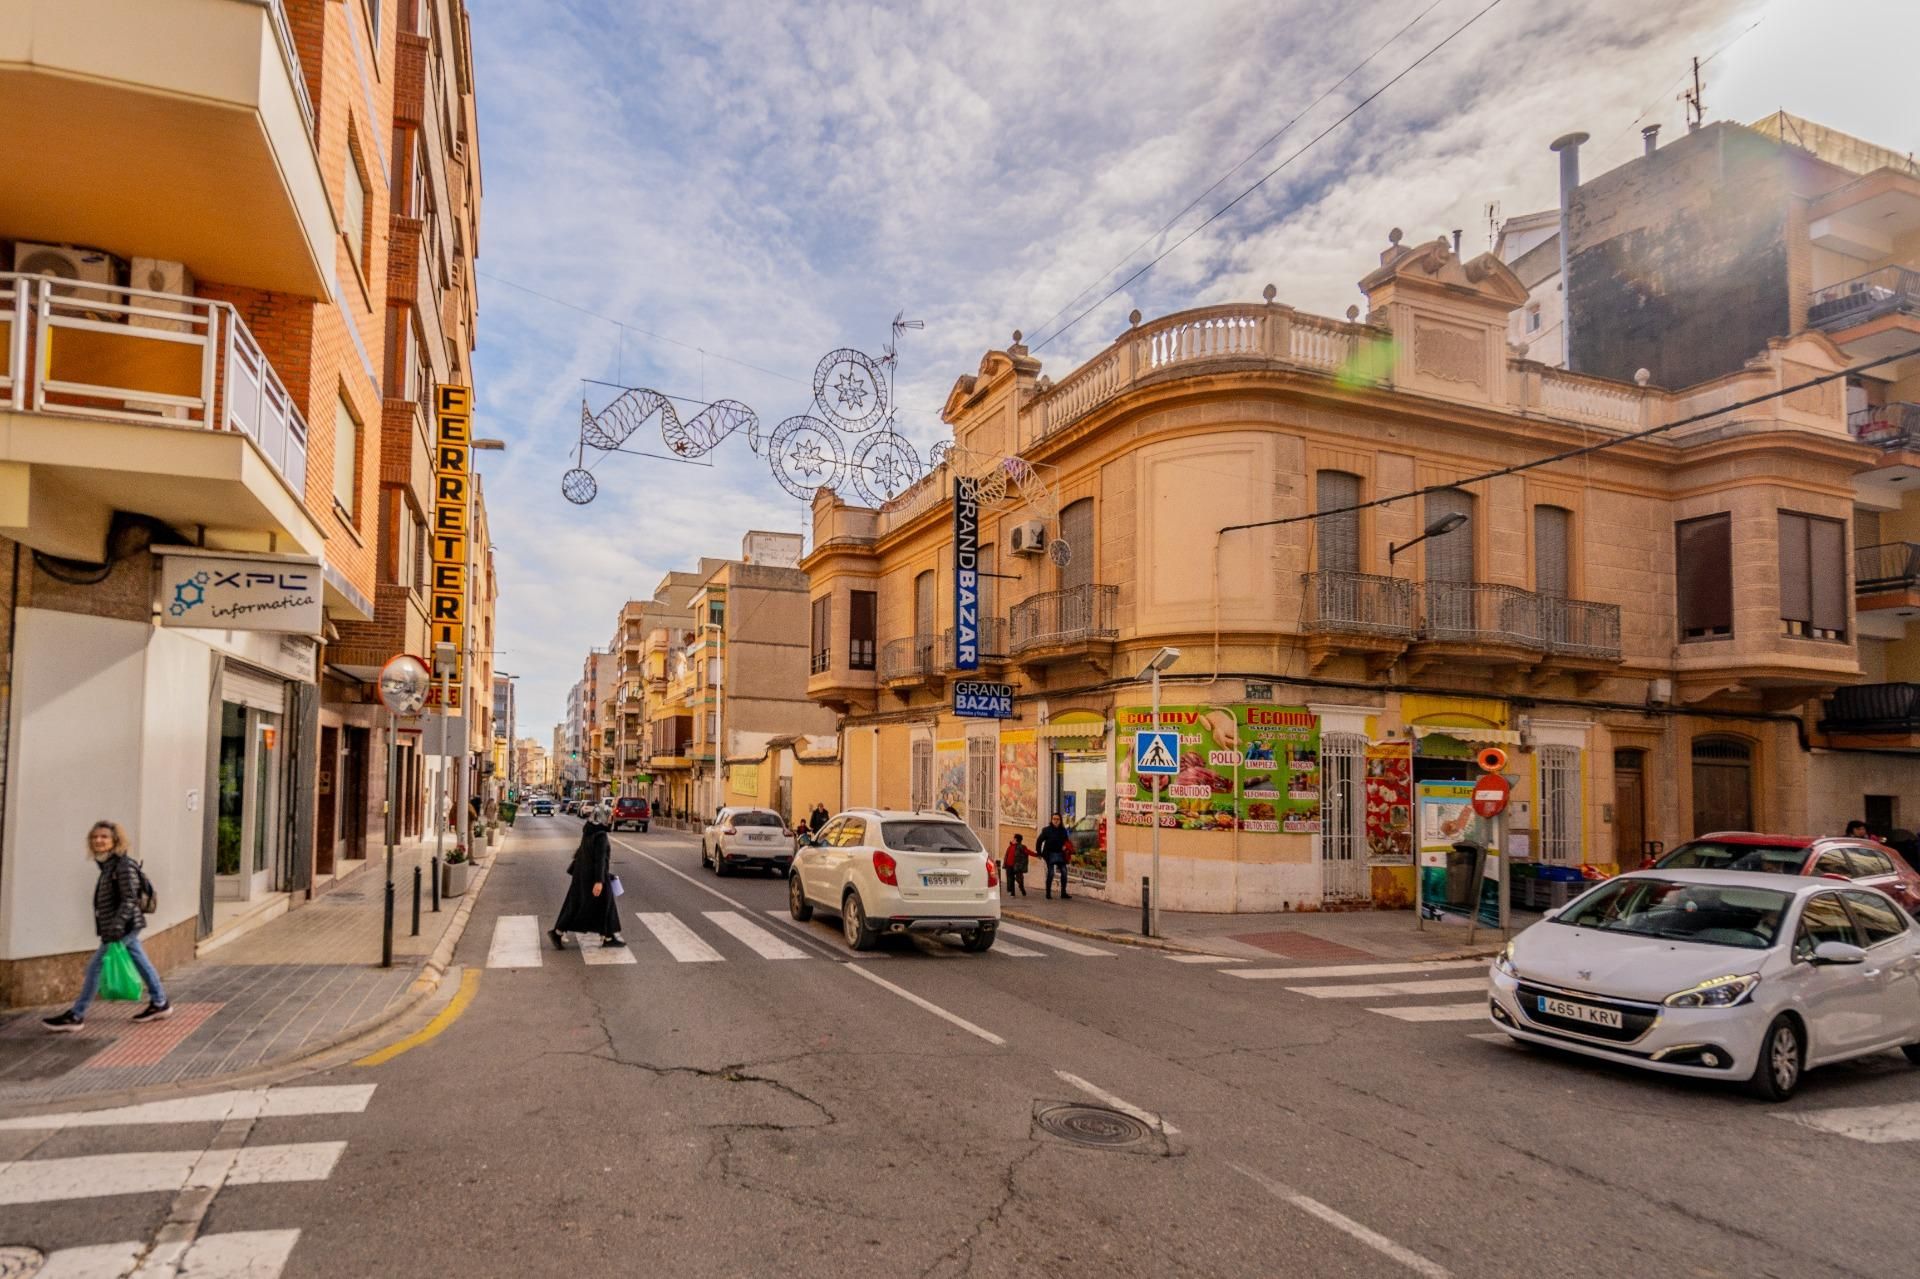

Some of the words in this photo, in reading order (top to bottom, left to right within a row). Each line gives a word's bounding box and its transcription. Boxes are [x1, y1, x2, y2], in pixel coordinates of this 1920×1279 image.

[433, 389, 466, 679] FERRETERI
[214, 570, 307, 591] XPC
[959, 570, 976, 664] BAZAR
[956, 682, 1012, 697] GRAND
[956, 694, 1012, 711] BAZAR
[1246, 761, 1277, 769] LIMPIEZA
[1170, 786, 1210, 797] EMBUTIDOS
[1142, 802, 1175, 811] veruras
[1548, 1001, 1583, 1018] 4651
[1589, 1008, 1619, 1025] KRV
